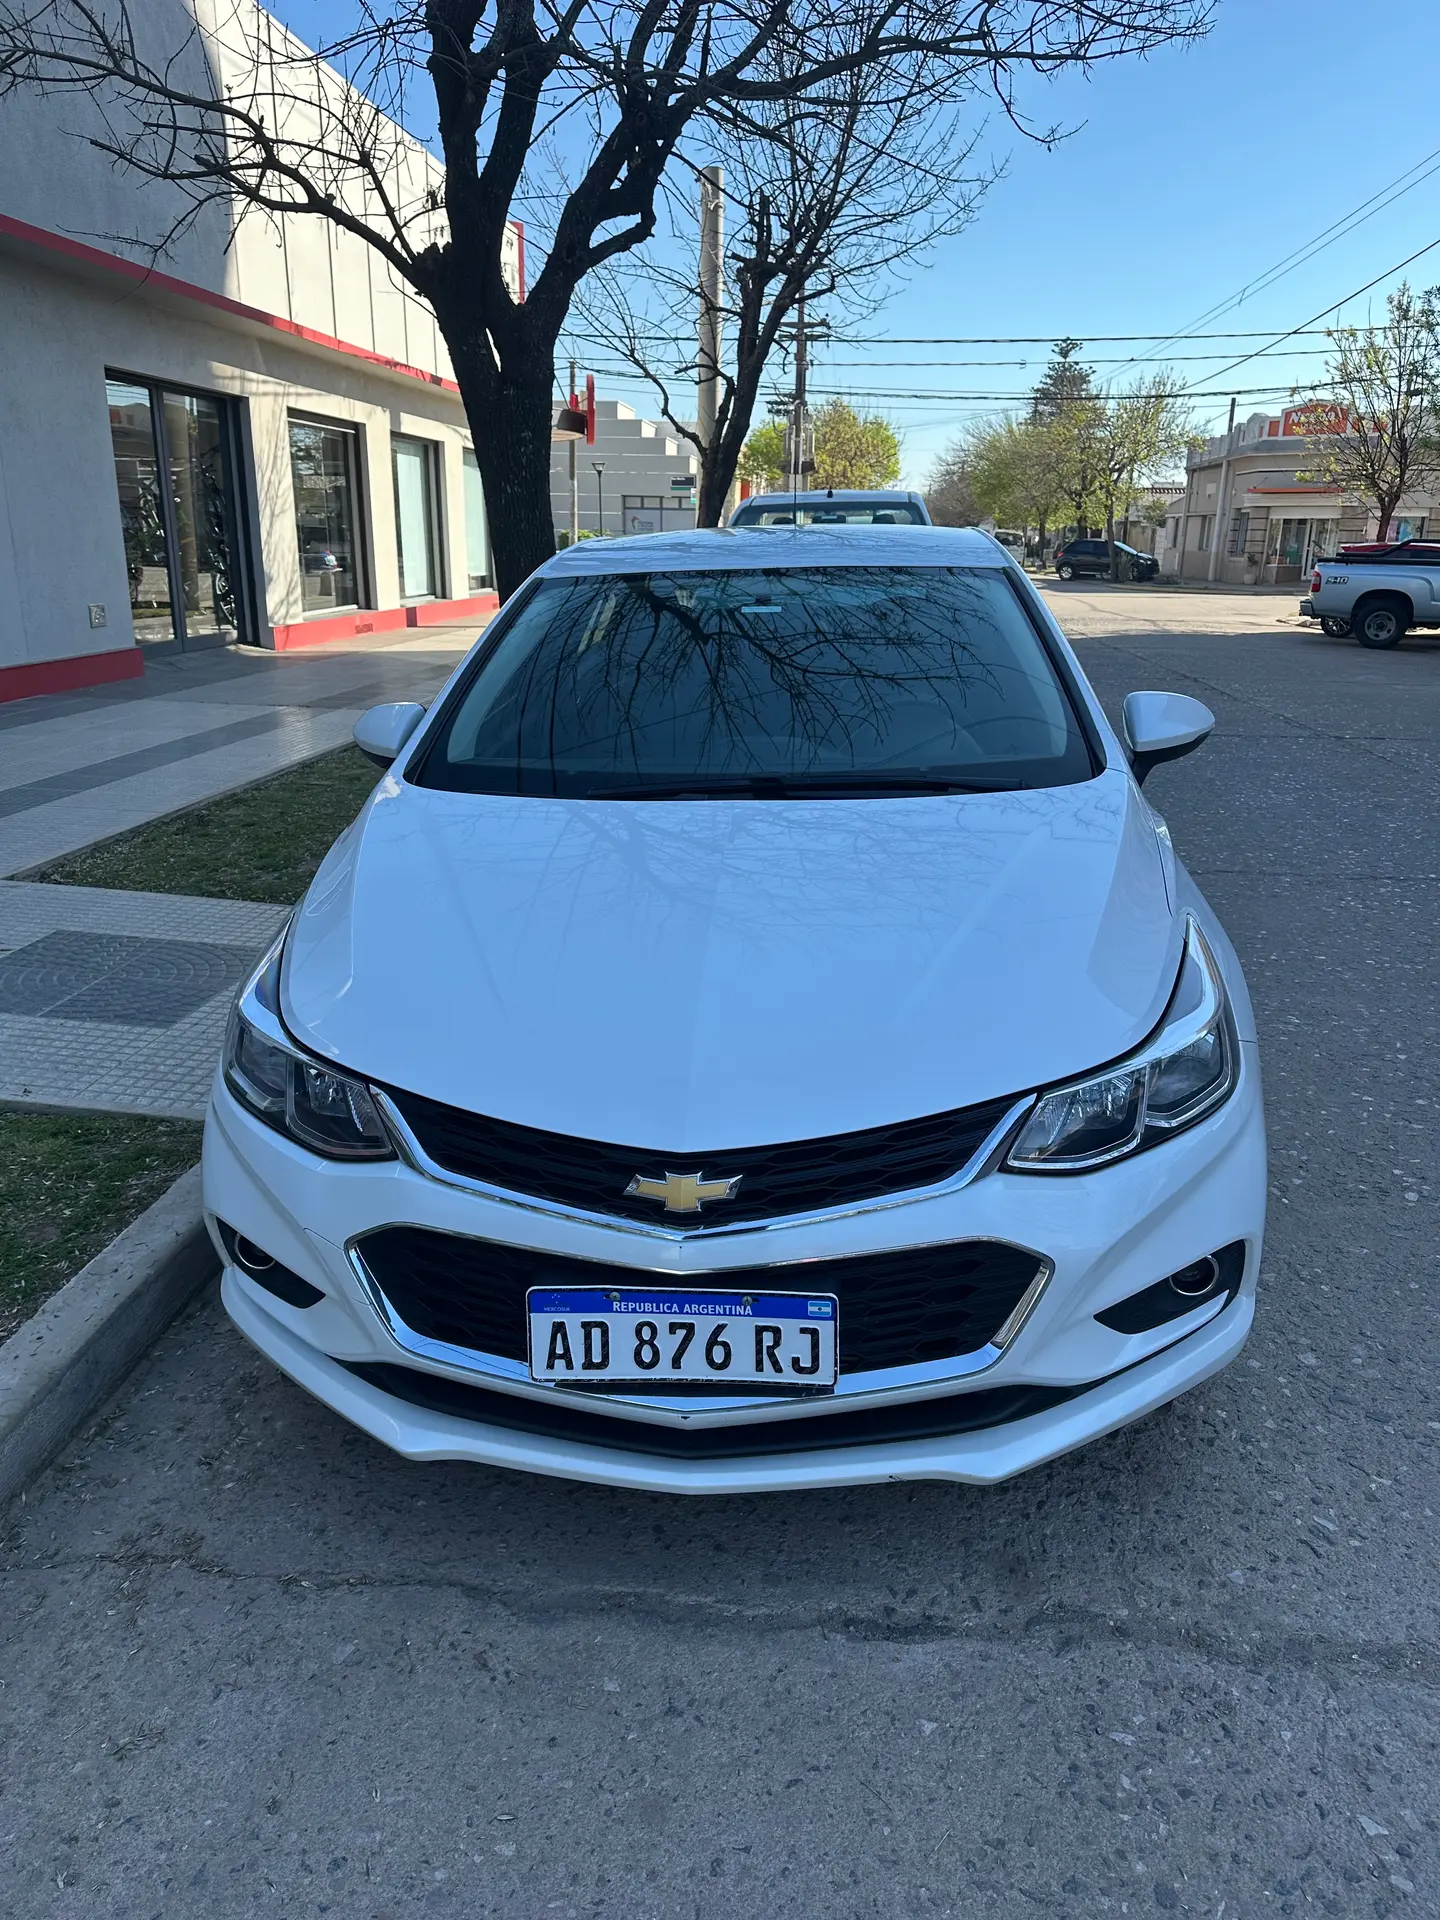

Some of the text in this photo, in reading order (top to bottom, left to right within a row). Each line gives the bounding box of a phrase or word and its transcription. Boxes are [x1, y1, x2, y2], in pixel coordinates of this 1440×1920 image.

[1325, 576, 1349, 585] S-10
[612, 1301, 753, 1316] REPUBLICA ARGENTINA
[545, 1320, 820, 1375] AD 876 RJ
